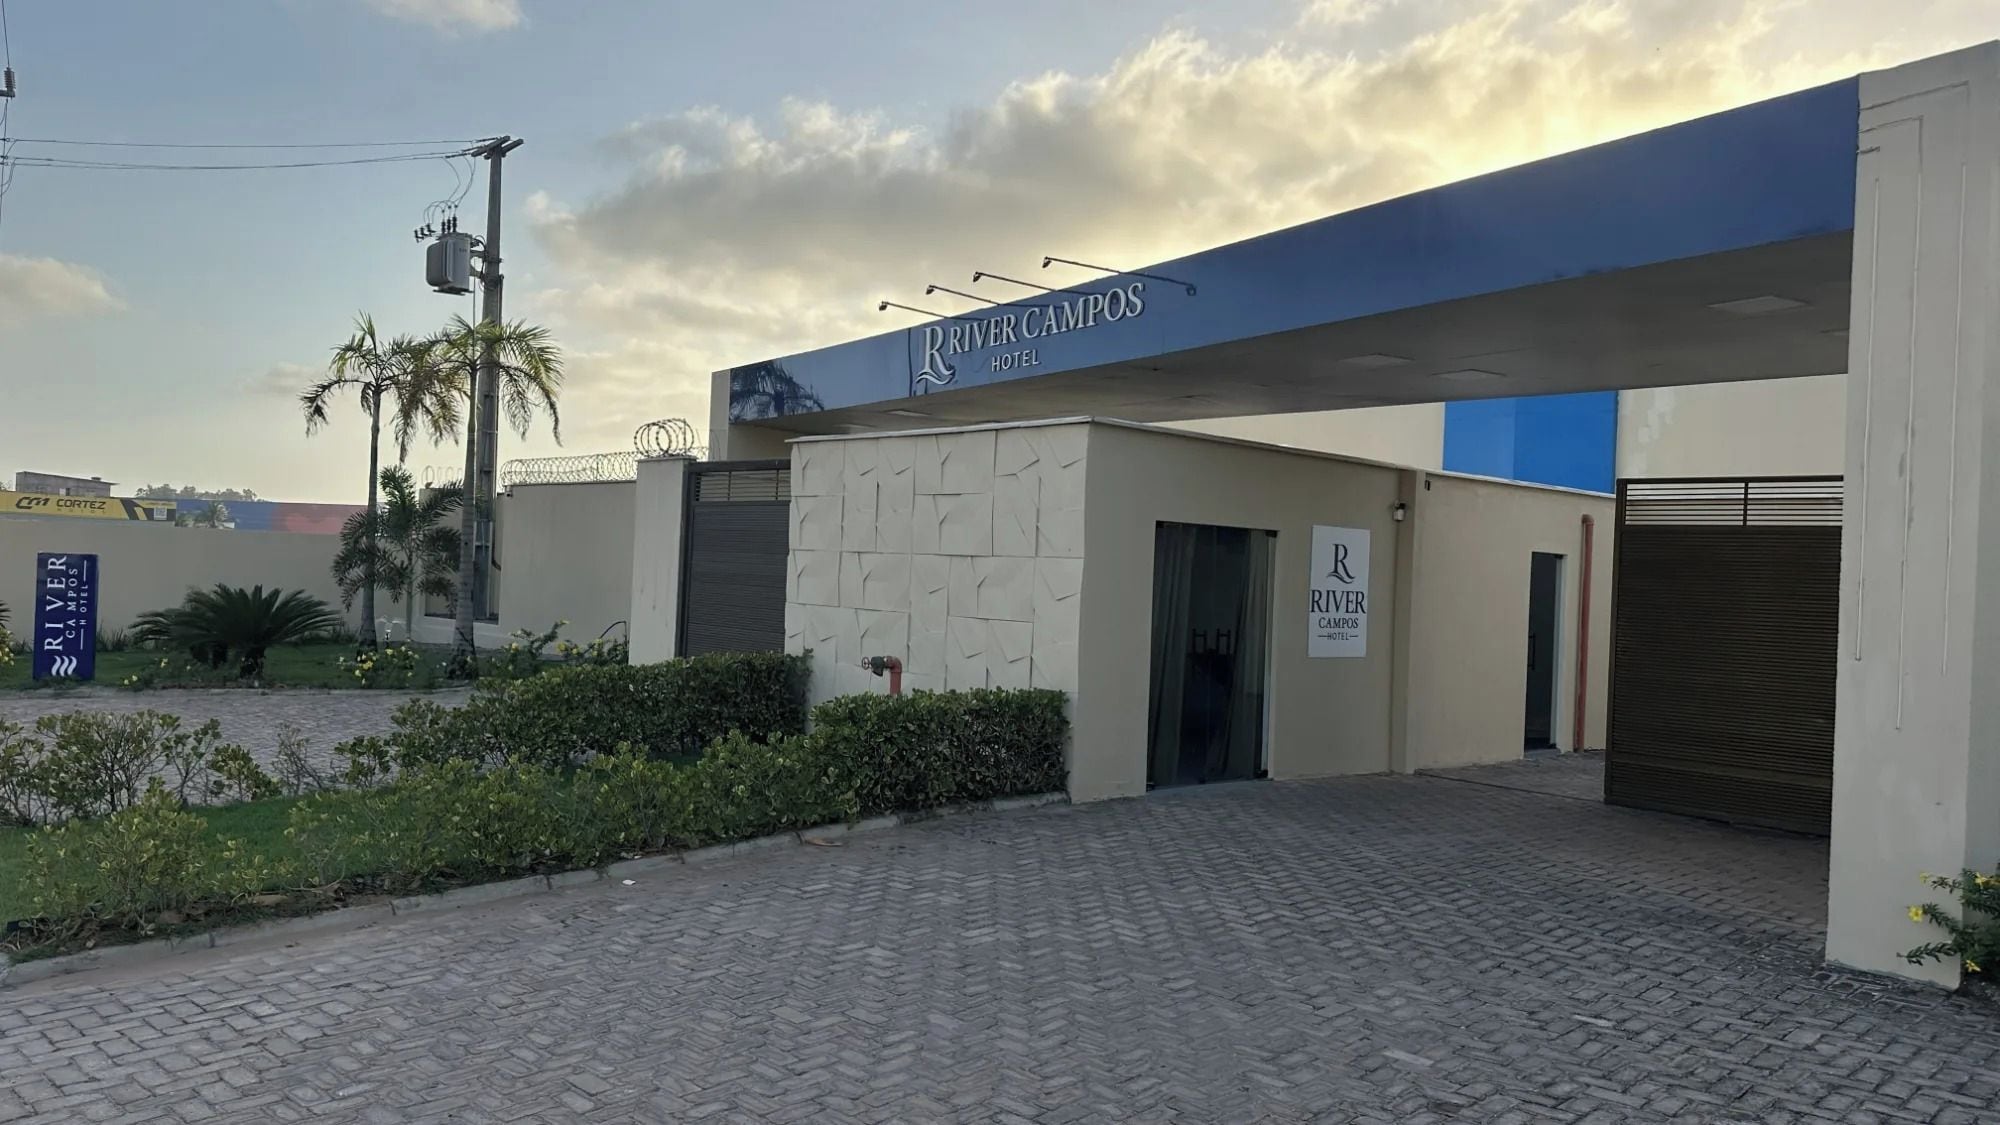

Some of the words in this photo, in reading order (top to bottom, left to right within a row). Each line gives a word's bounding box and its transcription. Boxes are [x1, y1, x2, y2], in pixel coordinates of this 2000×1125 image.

[950, 314, 1018, 355] RIVER
[1022, 282, 1145, 339] CAMPOS
[991, 349, 1042, 372] HOTEL
[56, 498, 107, 510] CORTEZ
[44, 556, 68, 651] RIVER
[65, 567, 79, 639] CAMPOS
[79, 584, 89, 625] HOTEL
[1310, 589, 1367, 614] RIVER
[1318, 616, 1359, 629] CAMPOS
[1326, 632, 1350, 640] HOTEL
